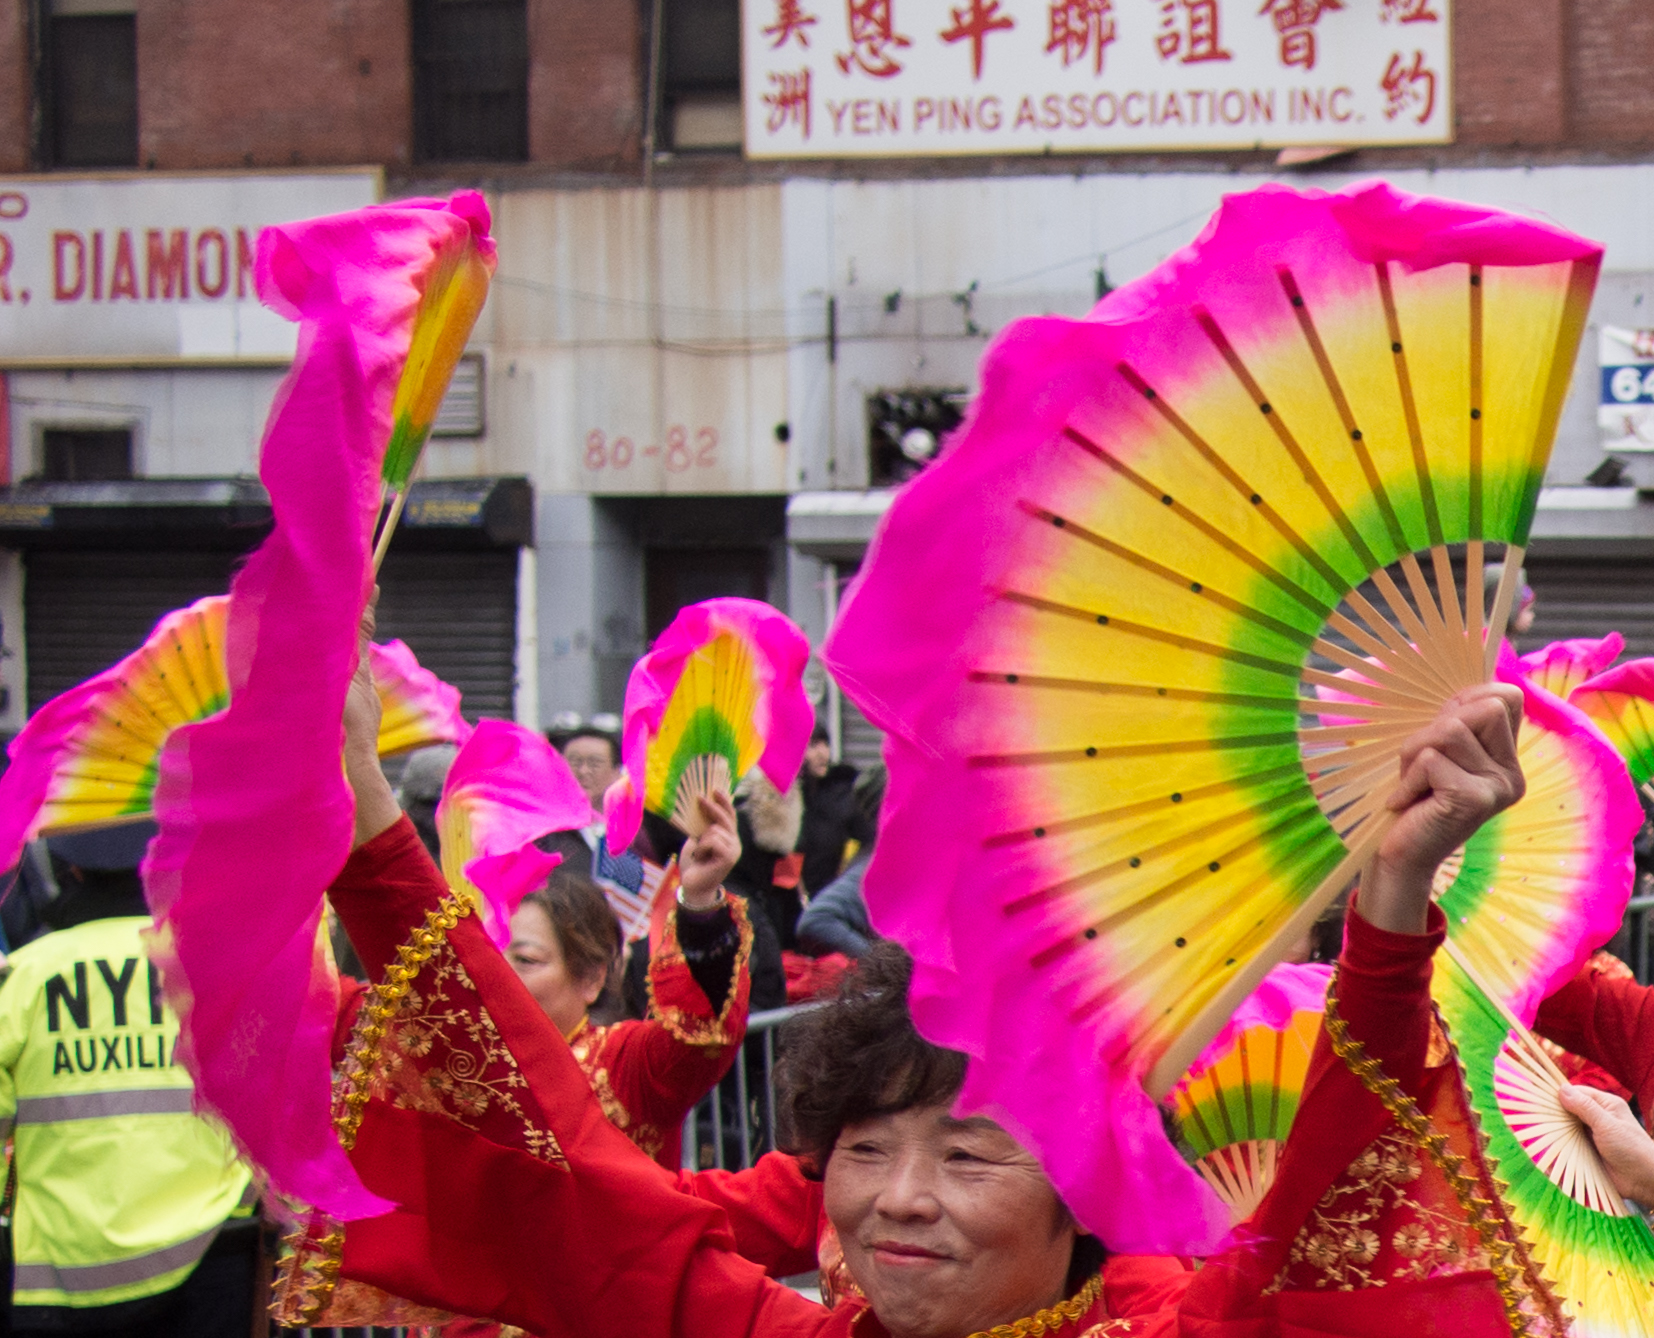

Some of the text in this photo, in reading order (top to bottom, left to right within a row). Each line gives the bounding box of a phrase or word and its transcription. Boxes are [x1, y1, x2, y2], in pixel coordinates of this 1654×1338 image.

[1376, 0, 1439, 125] 約
[825, 87, 1366, 135] YEN PING ASSOCIATION INC.
[584, 423, 720, 474] 80-82
